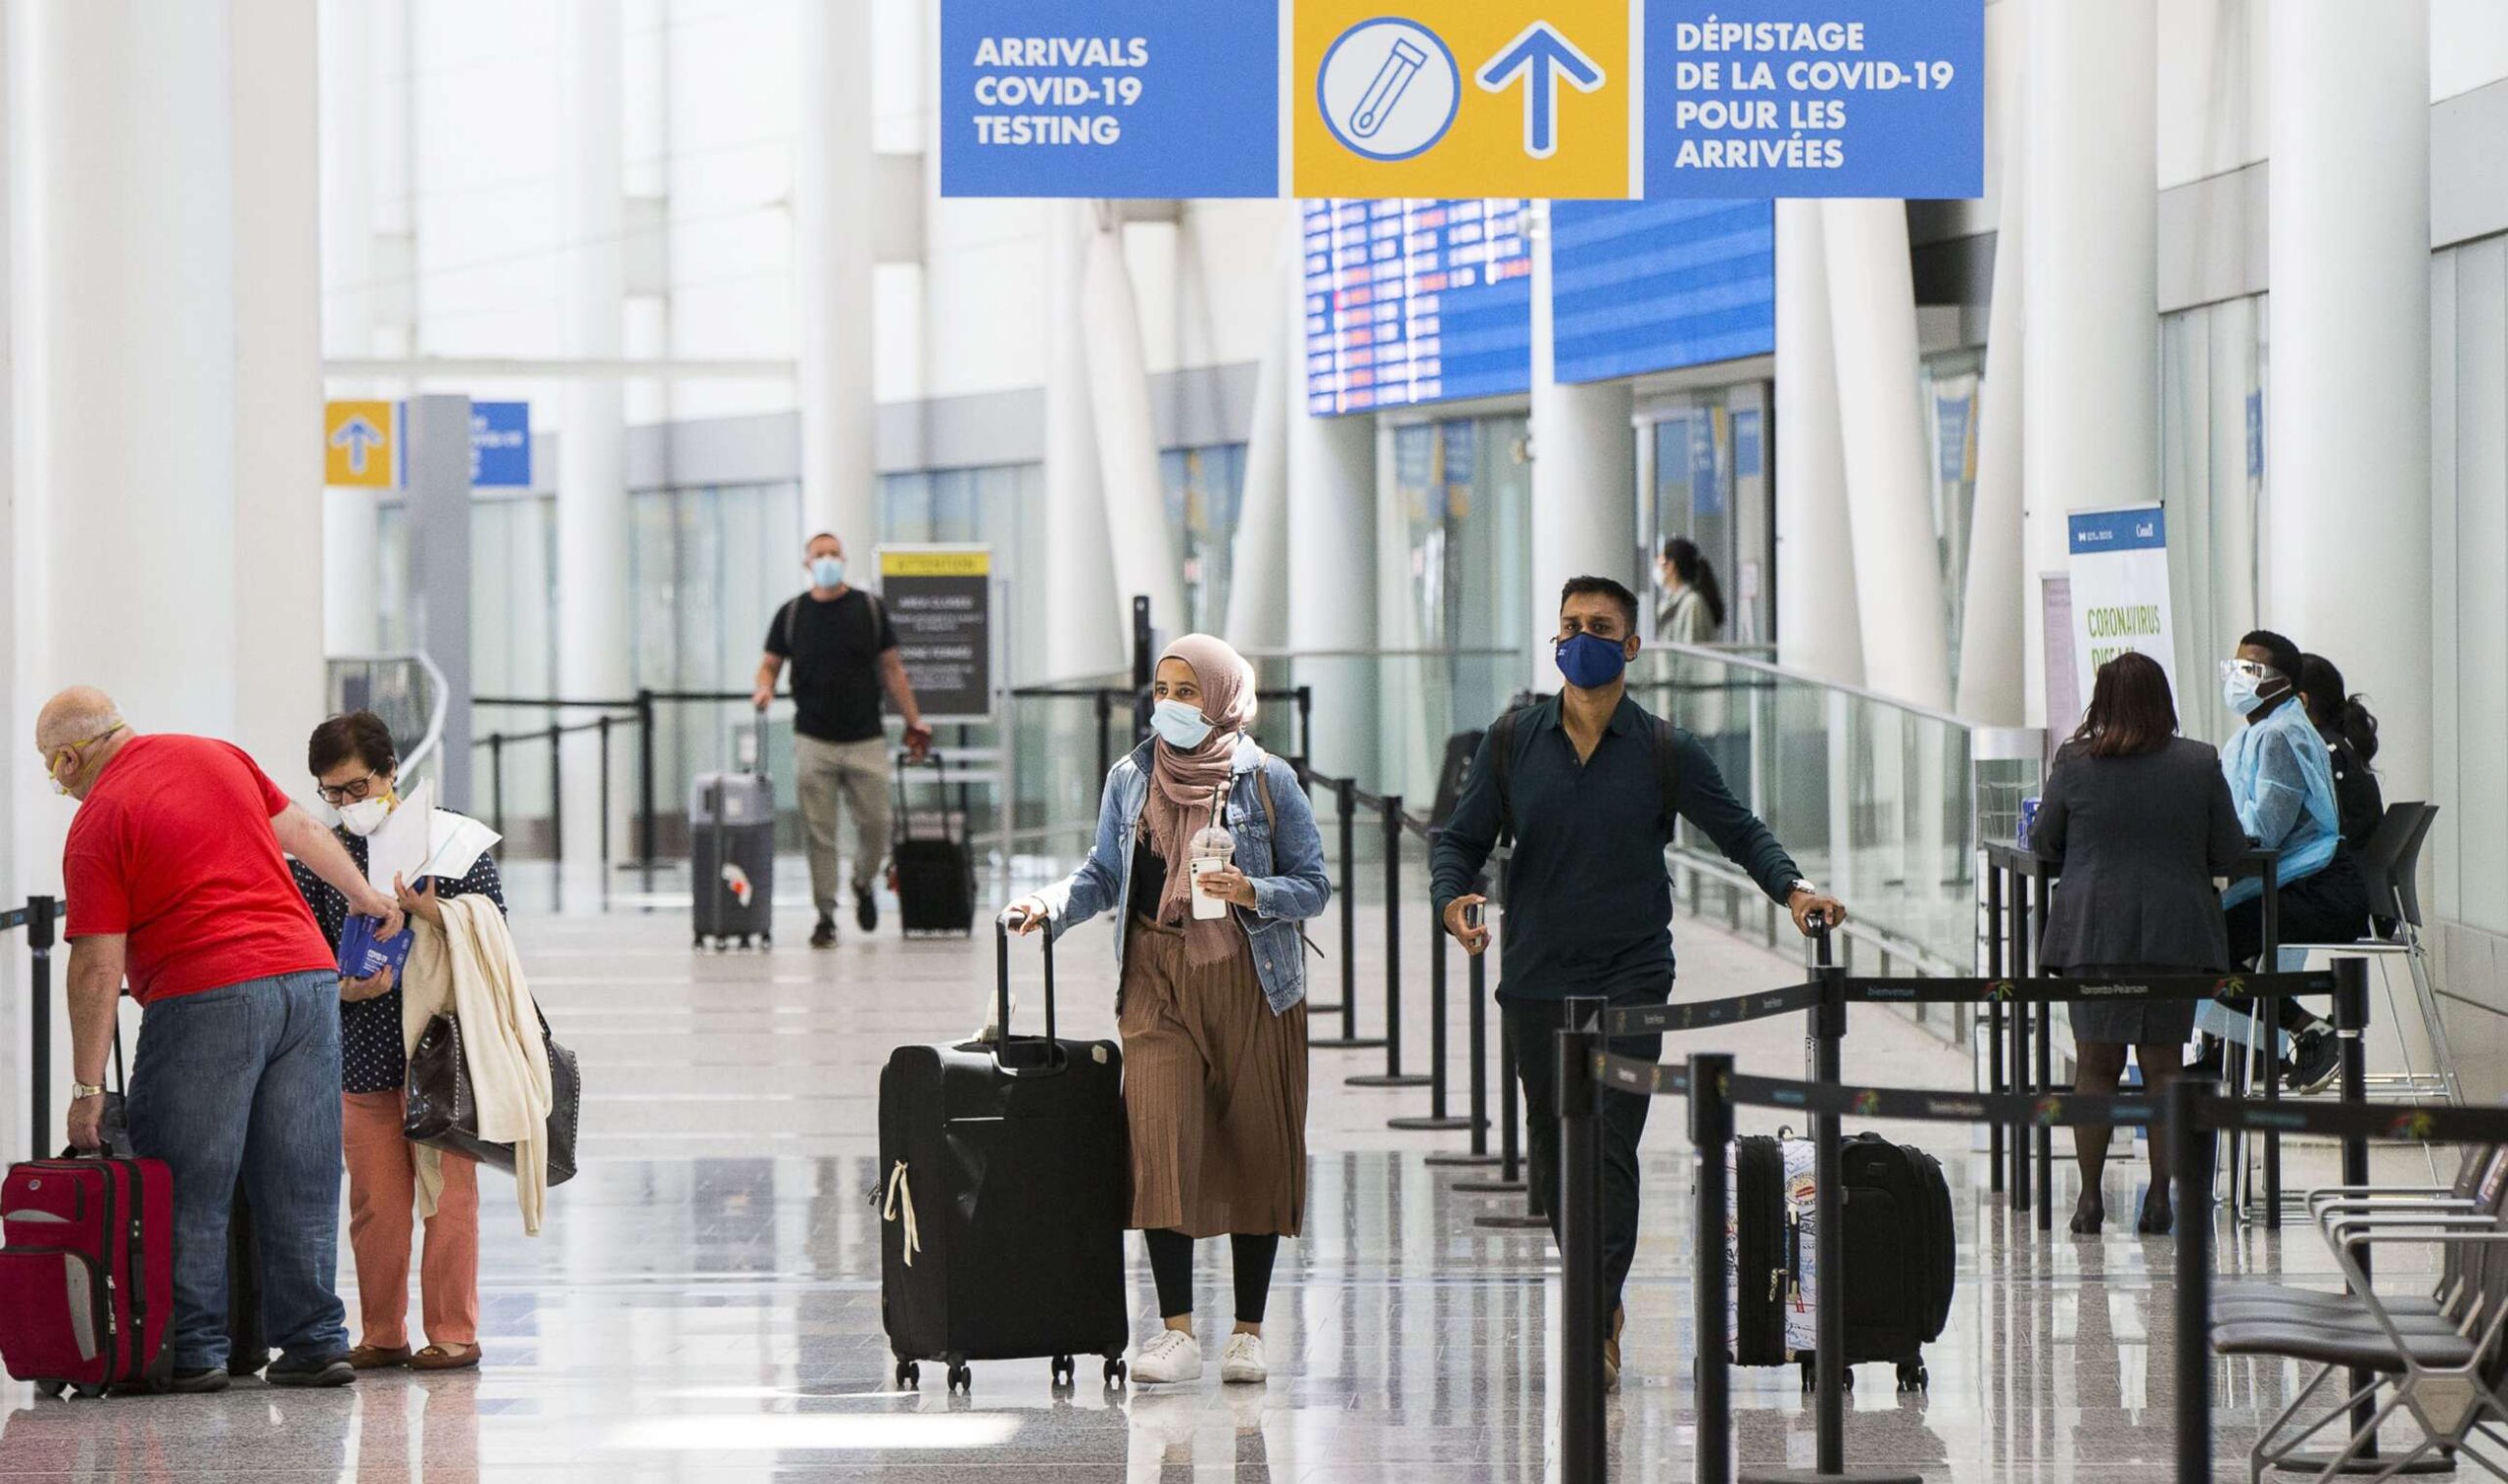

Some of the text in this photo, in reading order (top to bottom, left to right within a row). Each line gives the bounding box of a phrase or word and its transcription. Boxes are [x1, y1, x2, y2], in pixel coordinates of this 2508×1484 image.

[1675, 14, 1864, 52] DÉPISTAGE
[973, 37, 1149, 68] ARRIVALS
[973, 75, 1143, 106] COVID-19
[1675, 61, 1955, 91] DE LA COVID-19
[973, 115, 1122, 145] TESTING
[1675, 100, 1848, 129] POUR LES
[1674, 130, 1845, 168] ARRIVÉES
[2087, 604, 2161, 638] CORONAVIRUS
